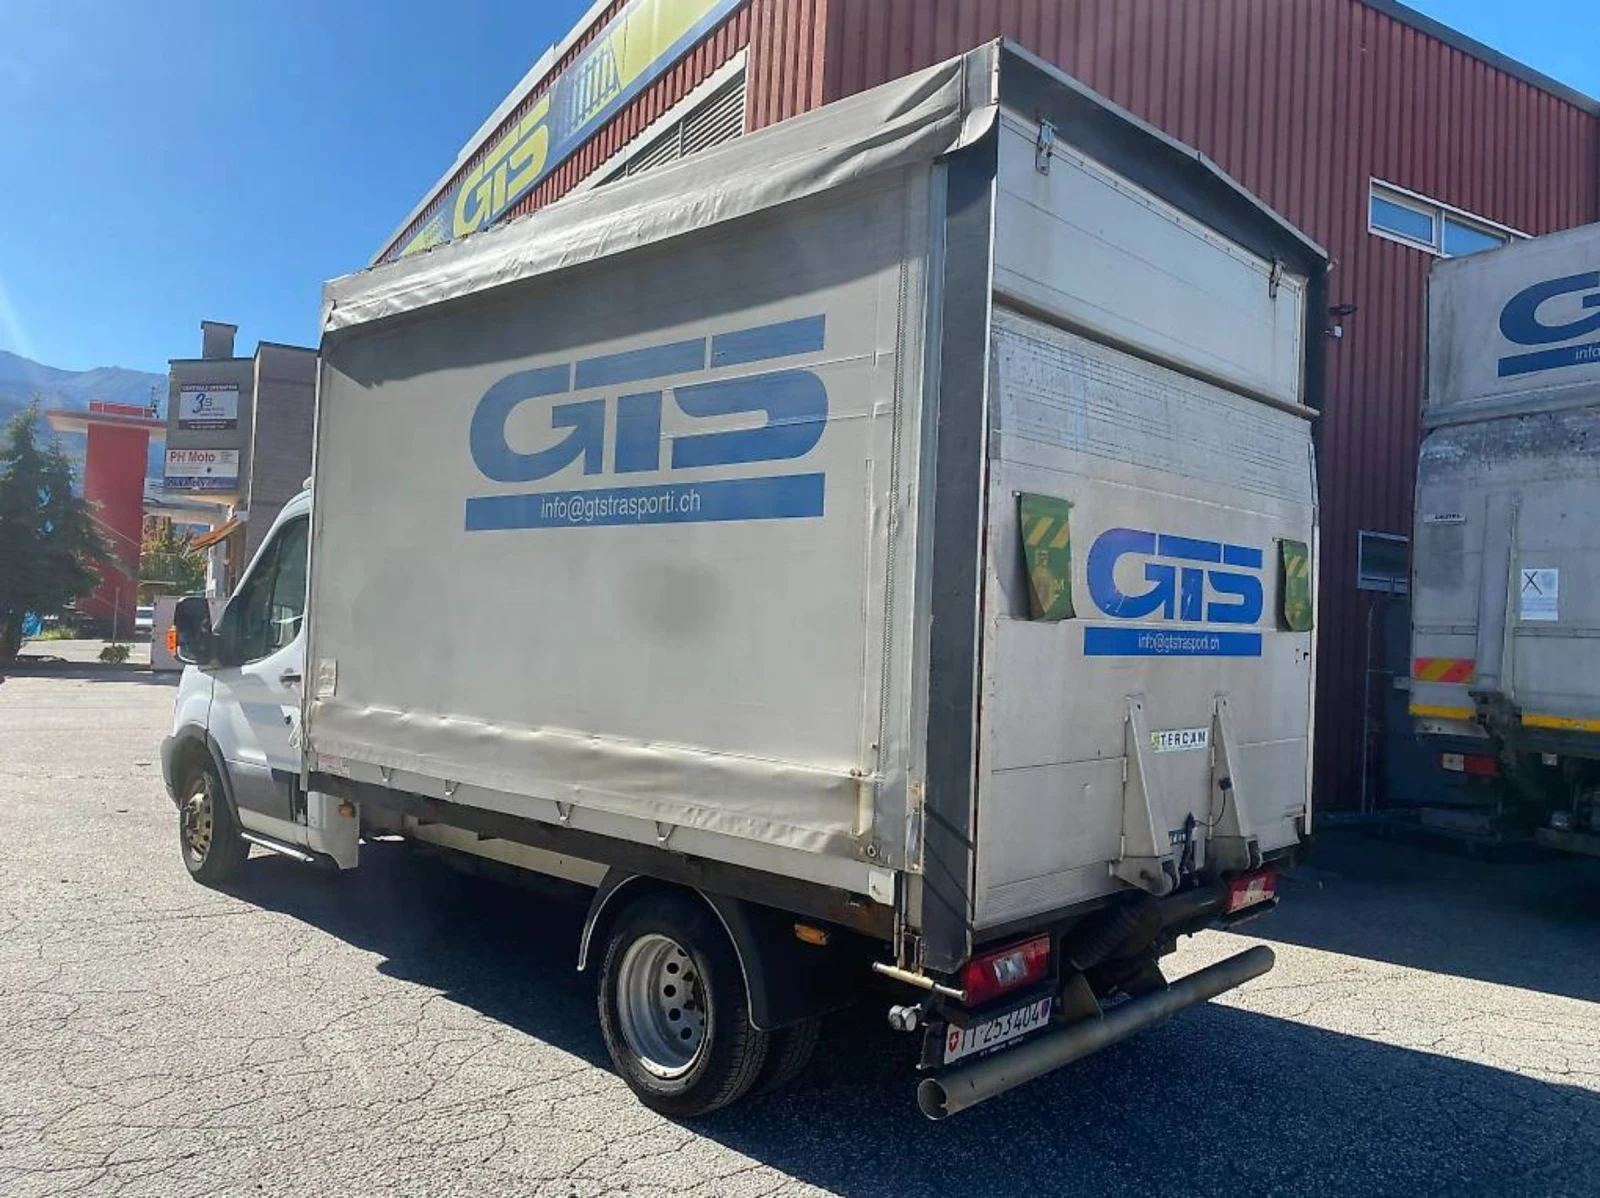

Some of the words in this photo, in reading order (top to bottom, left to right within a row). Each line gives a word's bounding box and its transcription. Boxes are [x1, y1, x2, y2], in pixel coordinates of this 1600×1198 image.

[453, 92, 549, 239] GTS
[470, 313, 829, 482] GTS
[170, 451, 186, 462] PH
[188, 451, 215, 462] Moto
[541, 488, 701, 522] info@gtstrasporti.ch
[1087, 527, 1264, 624] GTS
[1160, 731, 1206, 746] TERCAN
